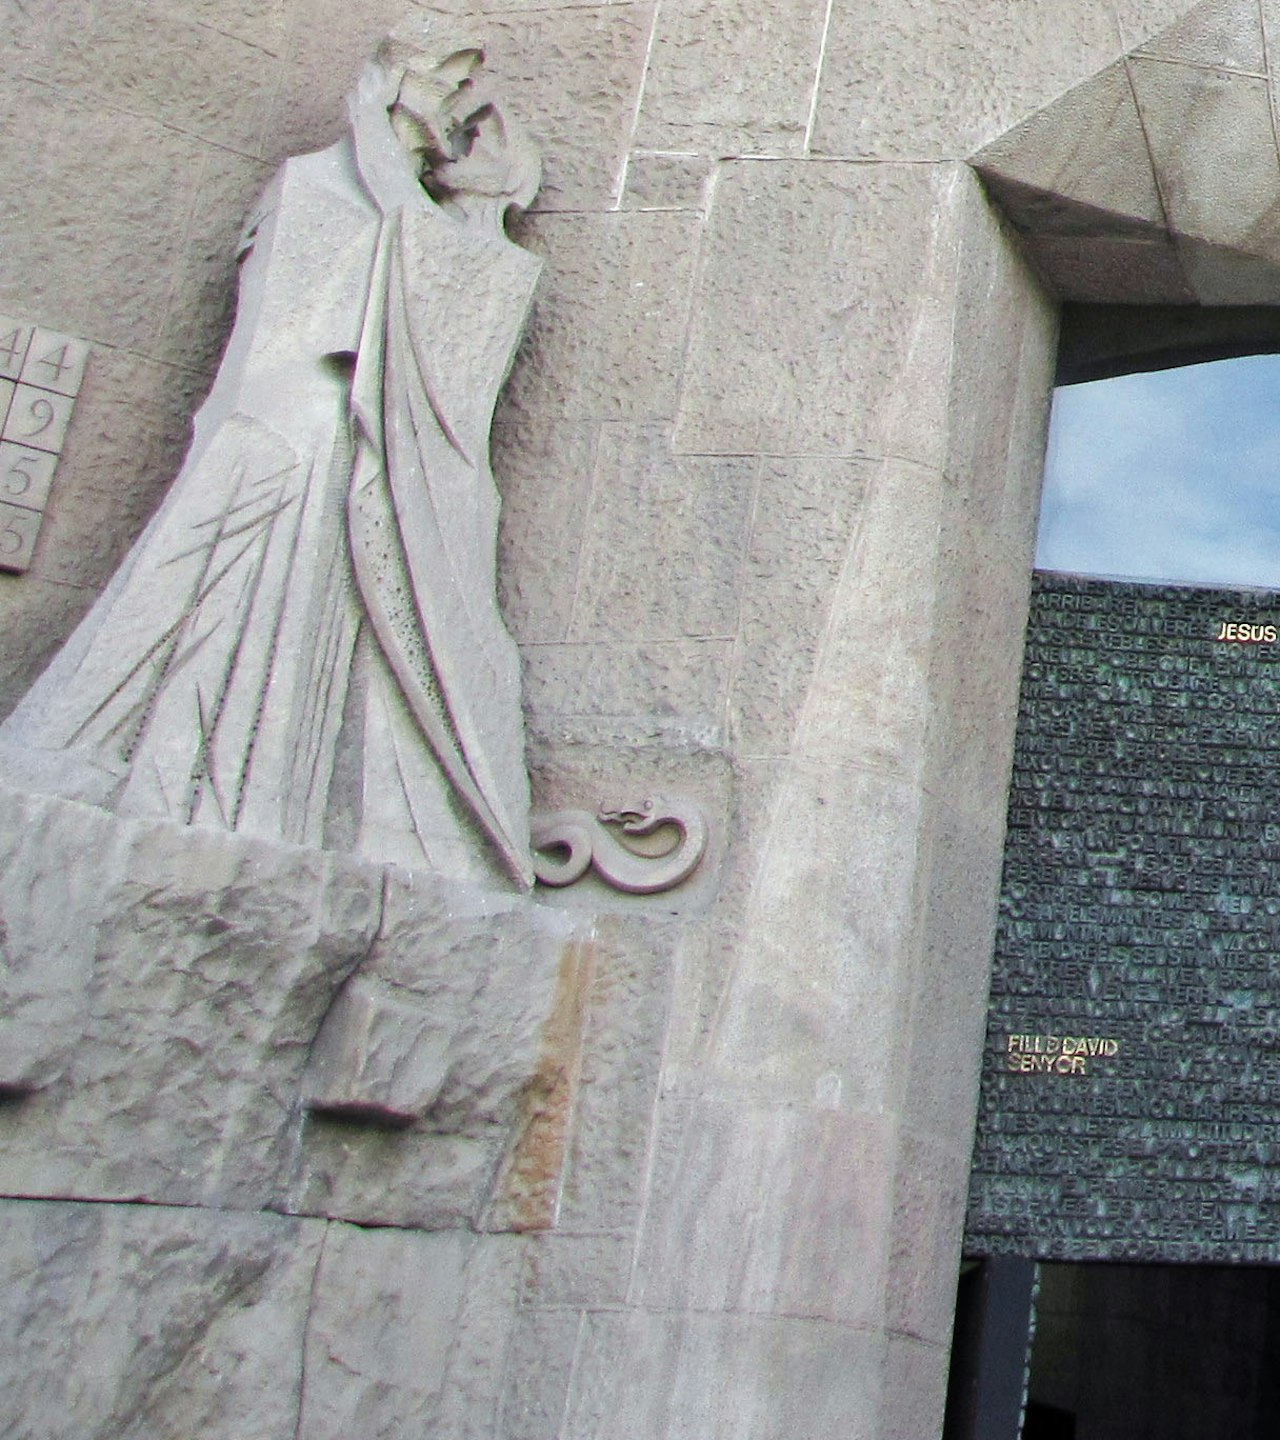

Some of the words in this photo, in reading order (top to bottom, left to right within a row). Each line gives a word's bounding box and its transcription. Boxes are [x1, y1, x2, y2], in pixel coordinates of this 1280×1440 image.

[37, 342, 71, 381] 4
[20, 398, 55, 438] 9
[5, 456, 39, 496] 5
[1057, 1038, 1116, 1060] DAVID
